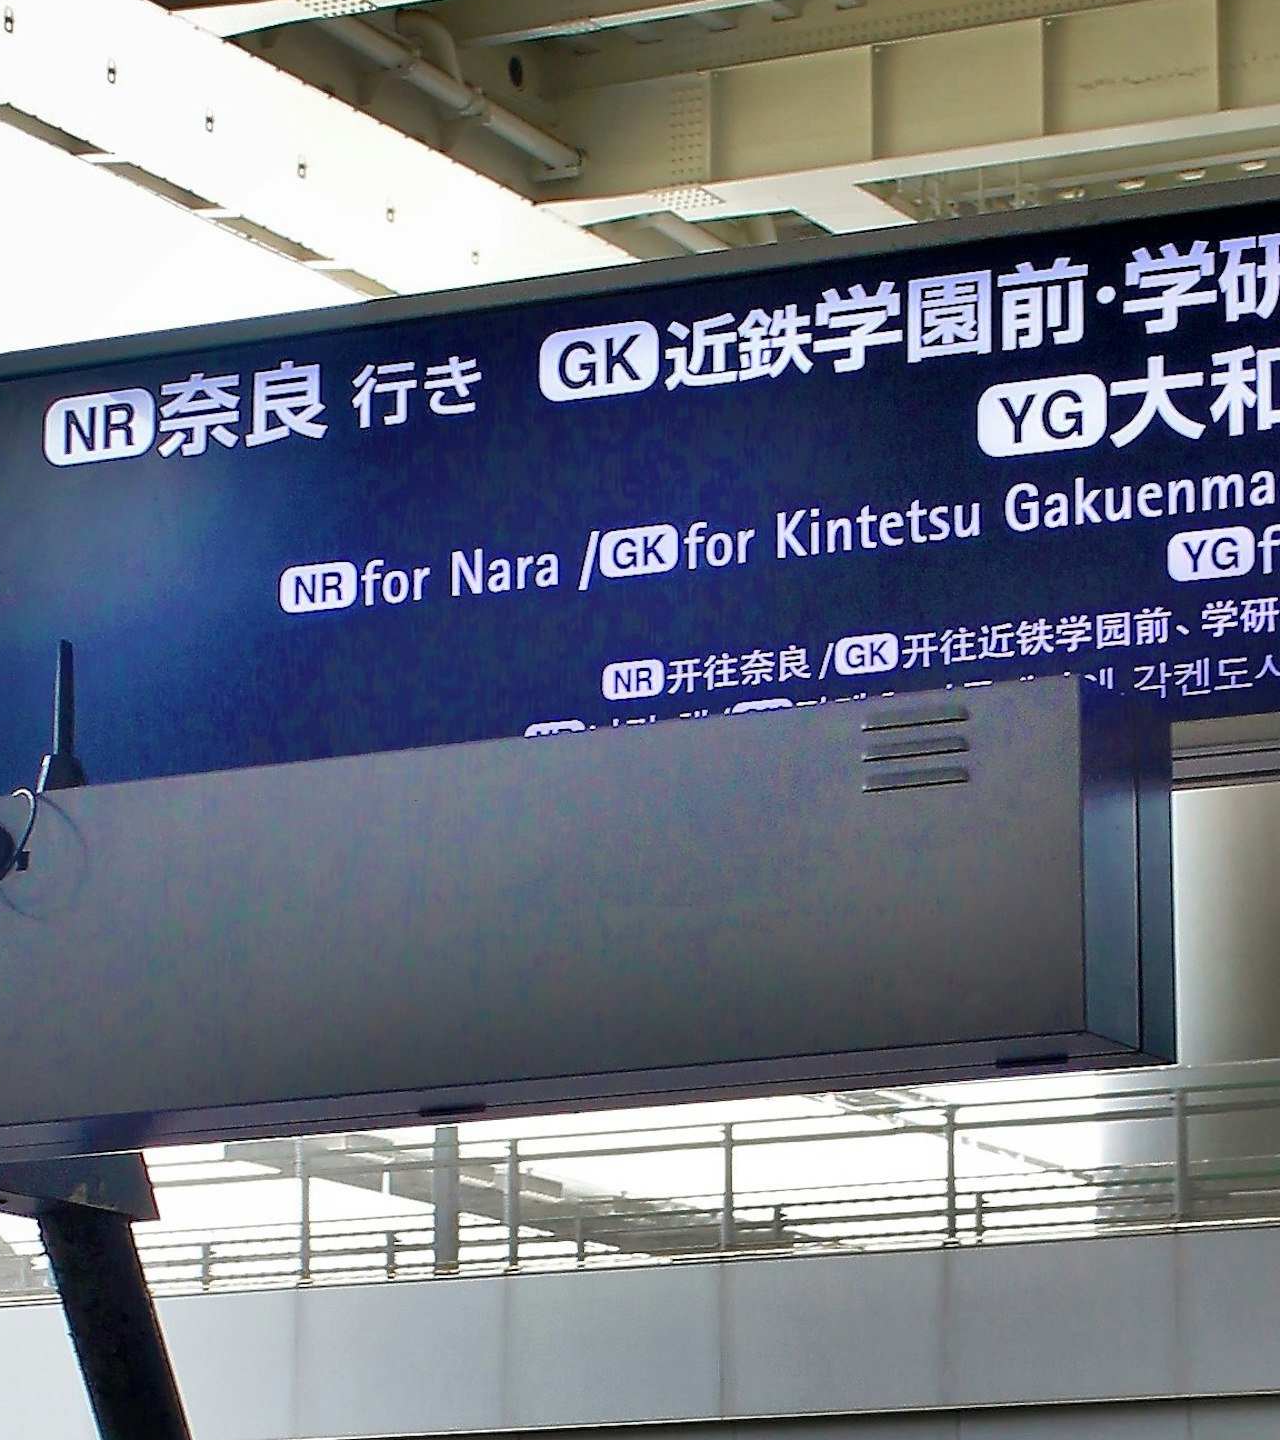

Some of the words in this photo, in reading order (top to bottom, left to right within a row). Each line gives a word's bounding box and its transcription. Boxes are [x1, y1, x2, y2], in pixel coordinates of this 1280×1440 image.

[157, 360, 329, 458] 奈良
[351, 355, 482, 429] 行き
[360, 559, 431, 607] for
[451, 548, 559, 597] Nara
[683, 521, 756, 570] for
[776, 499, 981, 559] Kintetsu
